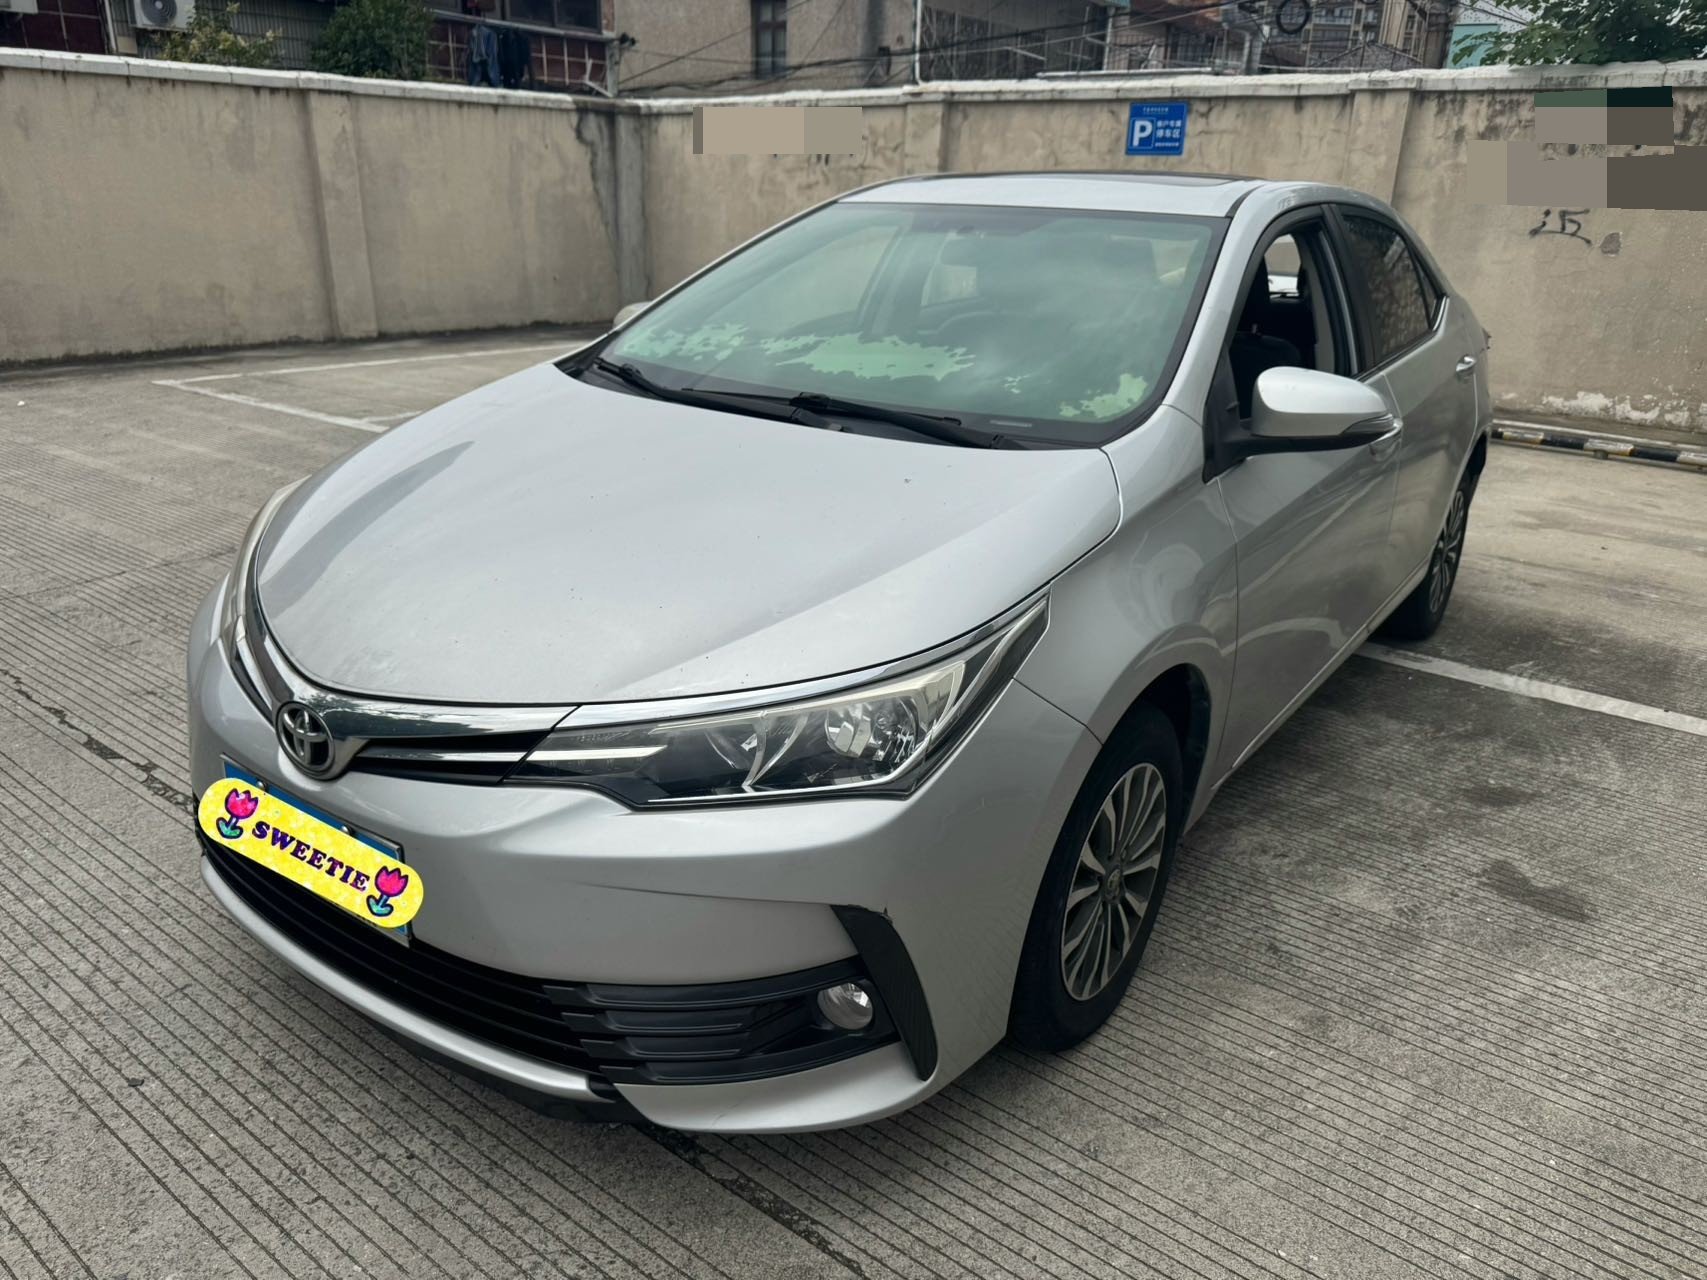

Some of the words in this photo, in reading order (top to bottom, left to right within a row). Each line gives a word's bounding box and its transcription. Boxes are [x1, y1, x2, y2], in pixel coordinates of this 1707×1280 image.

[1132, 120, 1153, 147] P
[1155, 128, 1181, 138] 停车区
